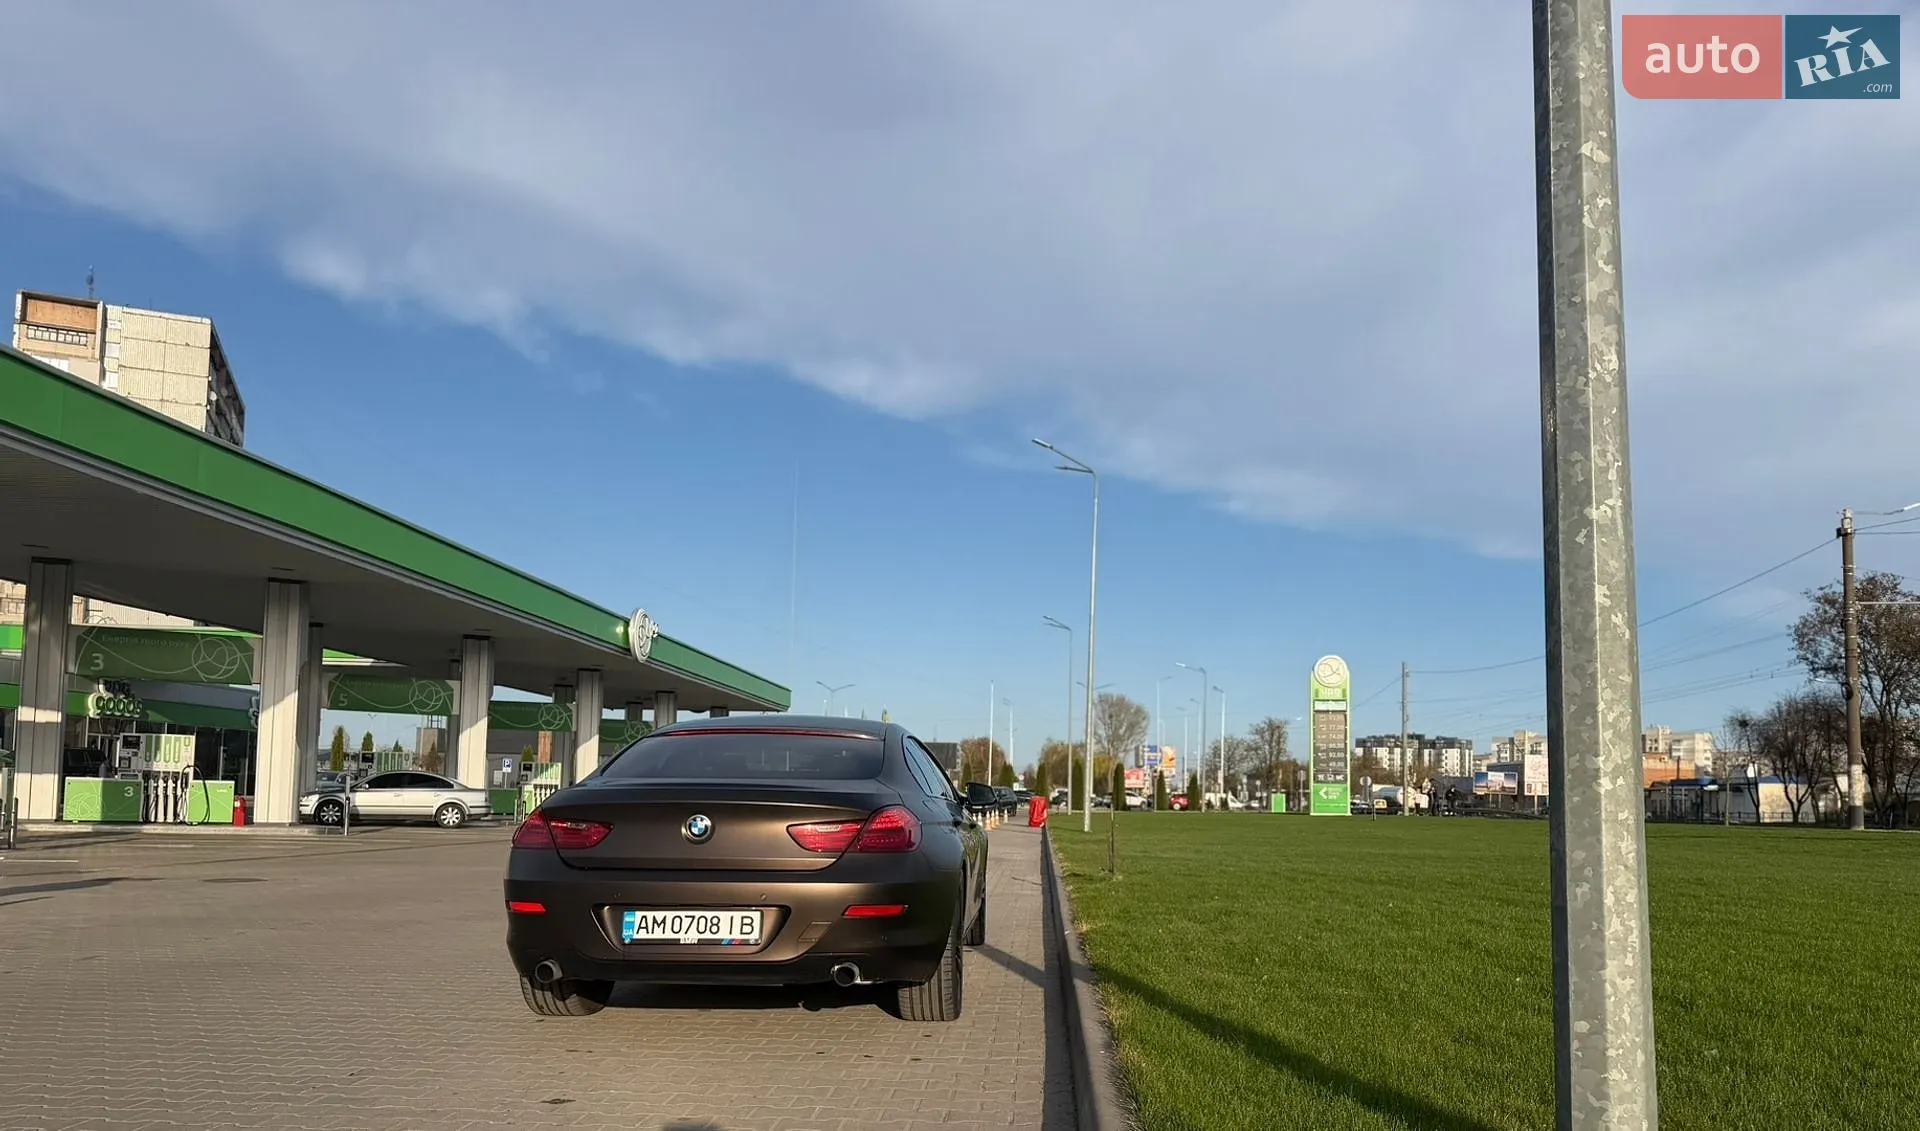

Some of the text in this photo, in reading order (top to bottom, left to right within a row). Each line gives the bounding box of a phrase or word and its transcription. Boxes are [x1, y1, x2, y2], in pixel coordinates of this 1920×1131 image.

[90, 652, 104, 671] 3
[338, 693, 348, 706] 5
[124, 787, 134, 797] 3
[636, 915, 754, 935] AM 0708 IB
